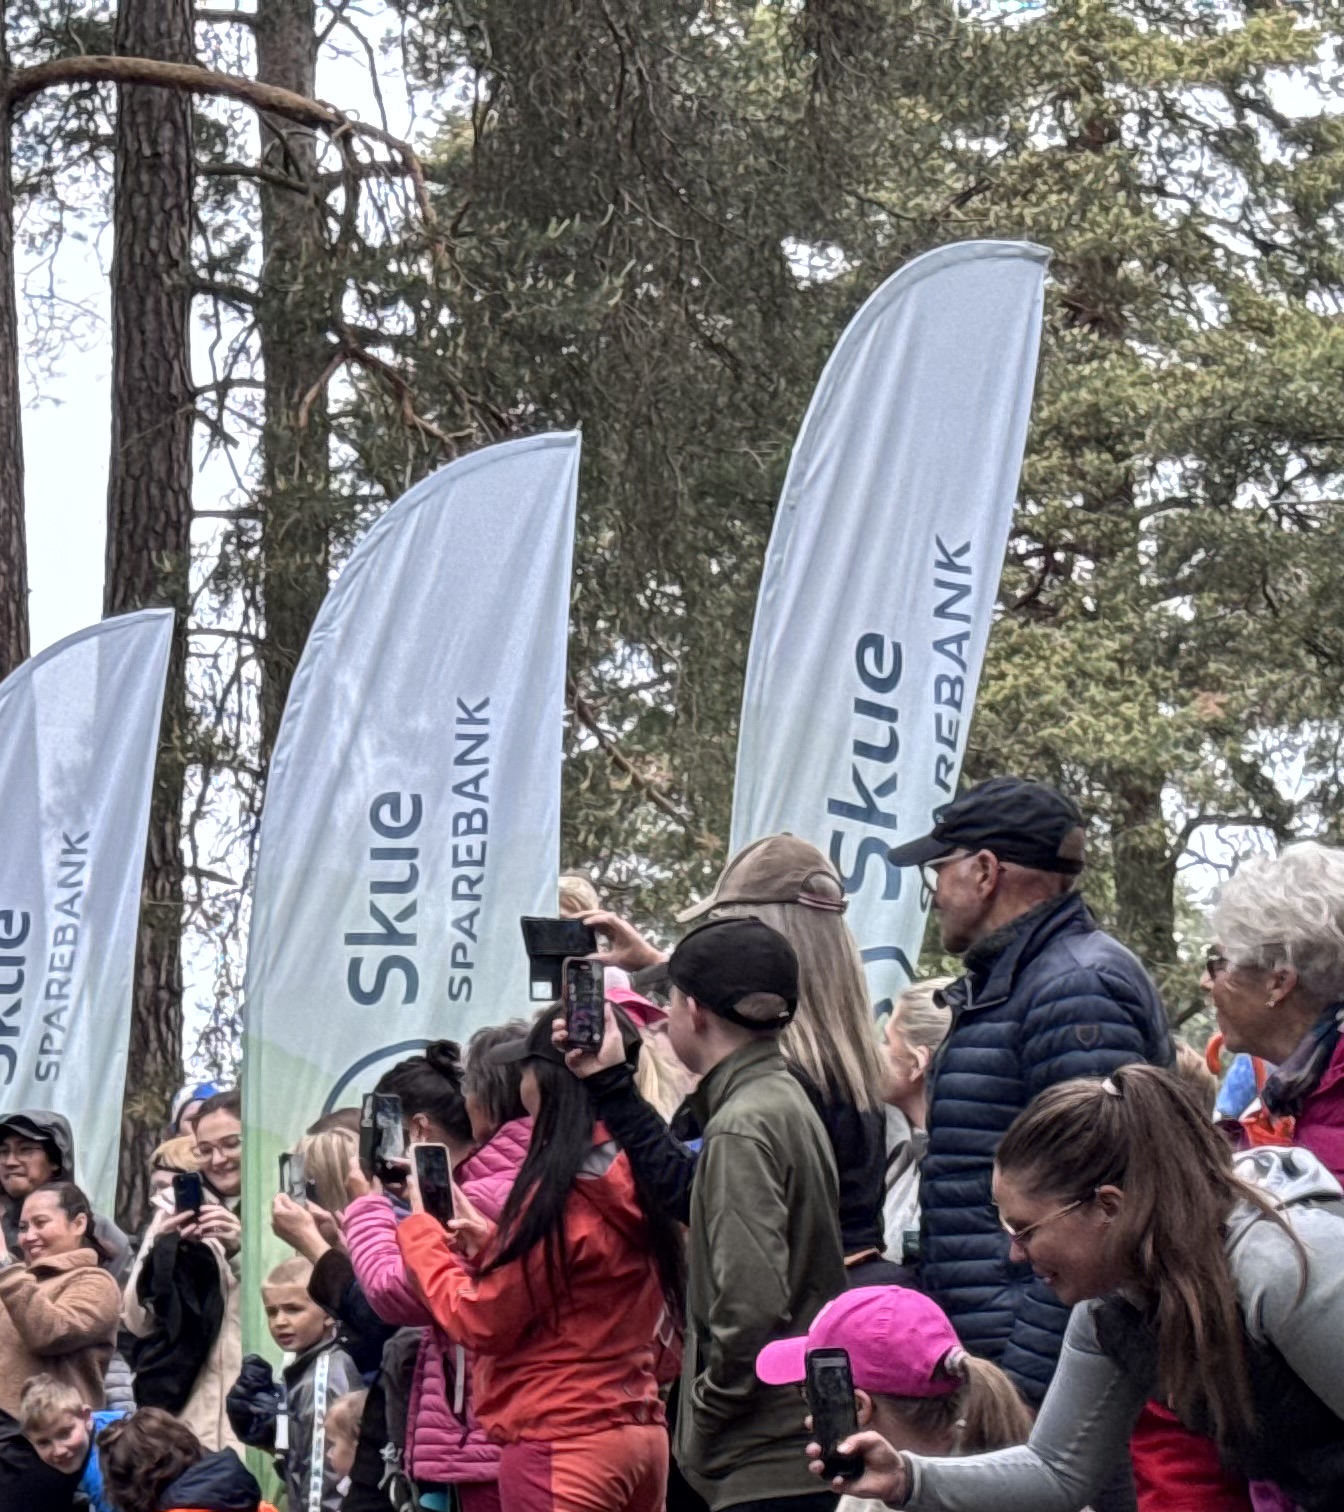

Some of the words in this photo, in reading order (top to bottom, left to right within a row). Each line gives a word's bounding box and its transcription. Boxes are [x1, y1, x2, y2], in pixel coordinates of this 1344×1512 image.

[447, 695, 491, 1003] SPAREBANK
[826, 631, 904, 901] Skue
[34, 830, 91, 1083] SPAREBANK
[343, 790, 424, 1006] Skue
